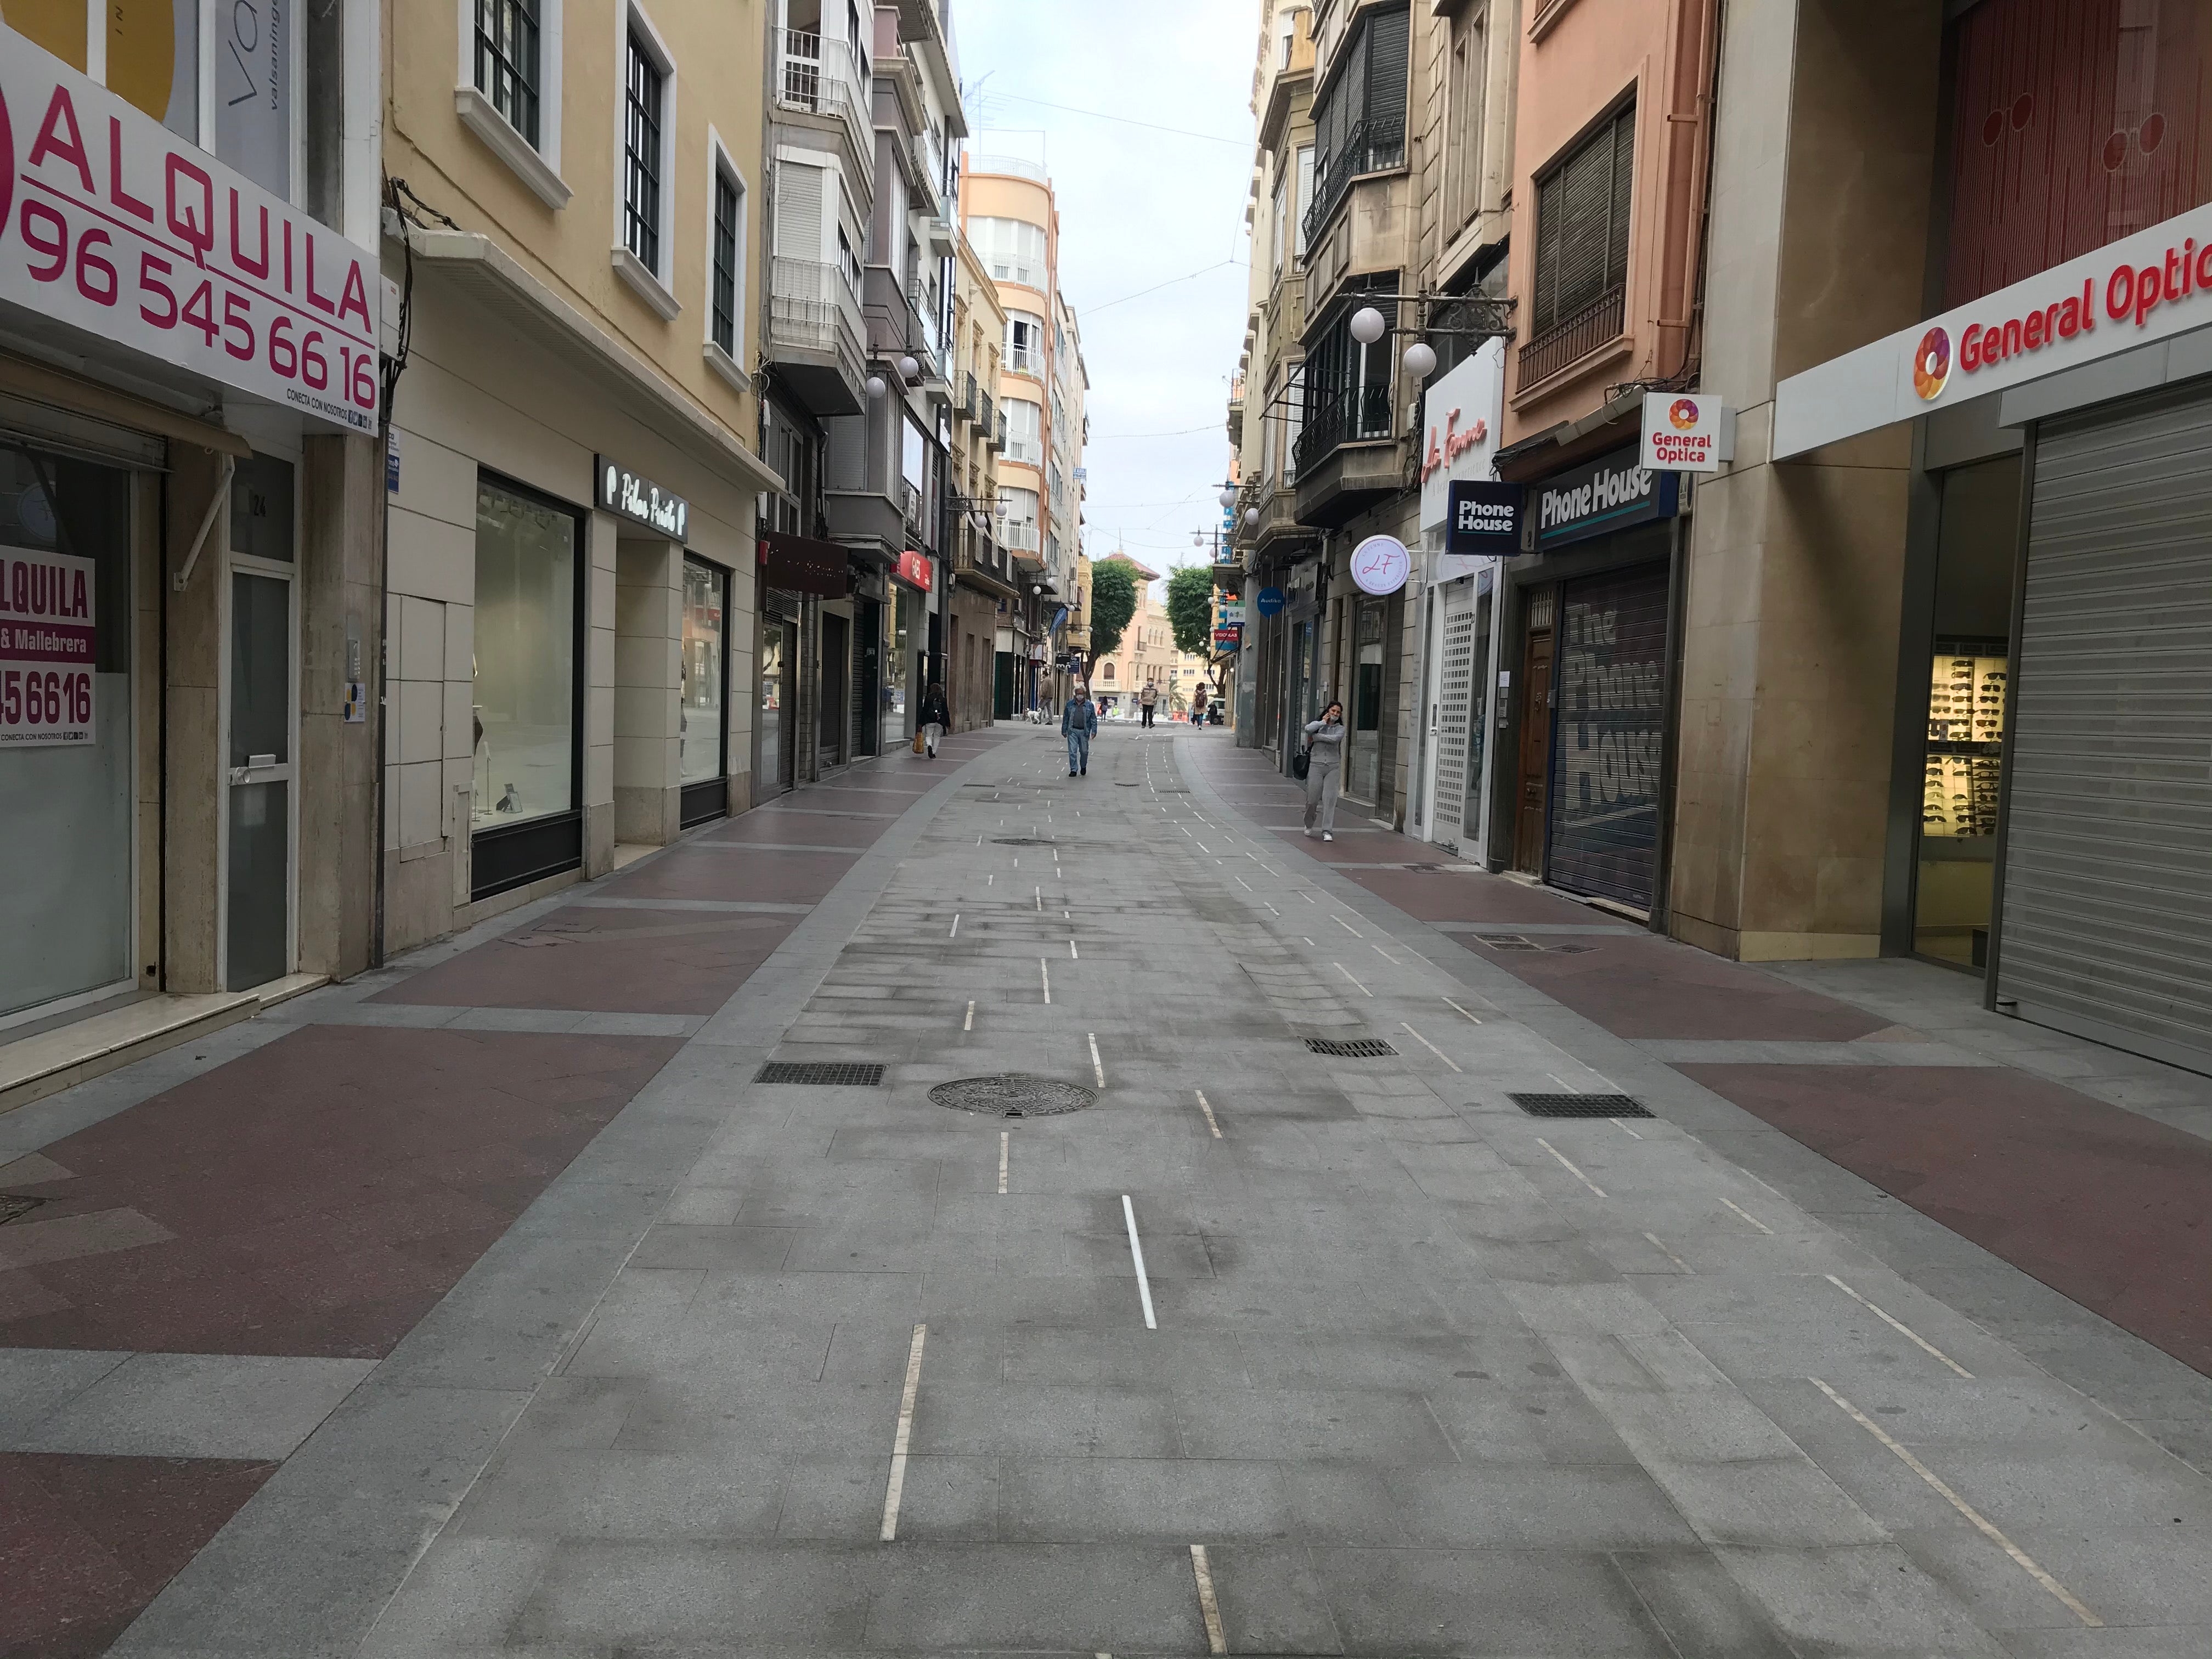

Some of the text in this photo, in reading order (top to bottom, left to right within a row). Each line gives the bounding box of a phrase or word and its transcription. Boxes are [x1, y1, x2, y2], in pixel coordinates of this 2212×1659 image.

[29, 84, 373, 335] ALQUILA
[20, 198, 376, 410] 96 545 66 16
[1960, 278, 2095, 372] General
[287, 388, 348, 420] CONECTA CON NOSOTROS
[1652, 432, 1712, 448] General
[1656, 447, 1706, 464] Optica
[1459, 500, 1514, 517] Phone
[1541, 465, 1653, 529] Phone House
[1458, 515, 1513, 532] House
[14, 628, 87, 653] Mallebrera
[1565, 603, 1617, 645] The
[1565, 650, 1660, 711] Phone
